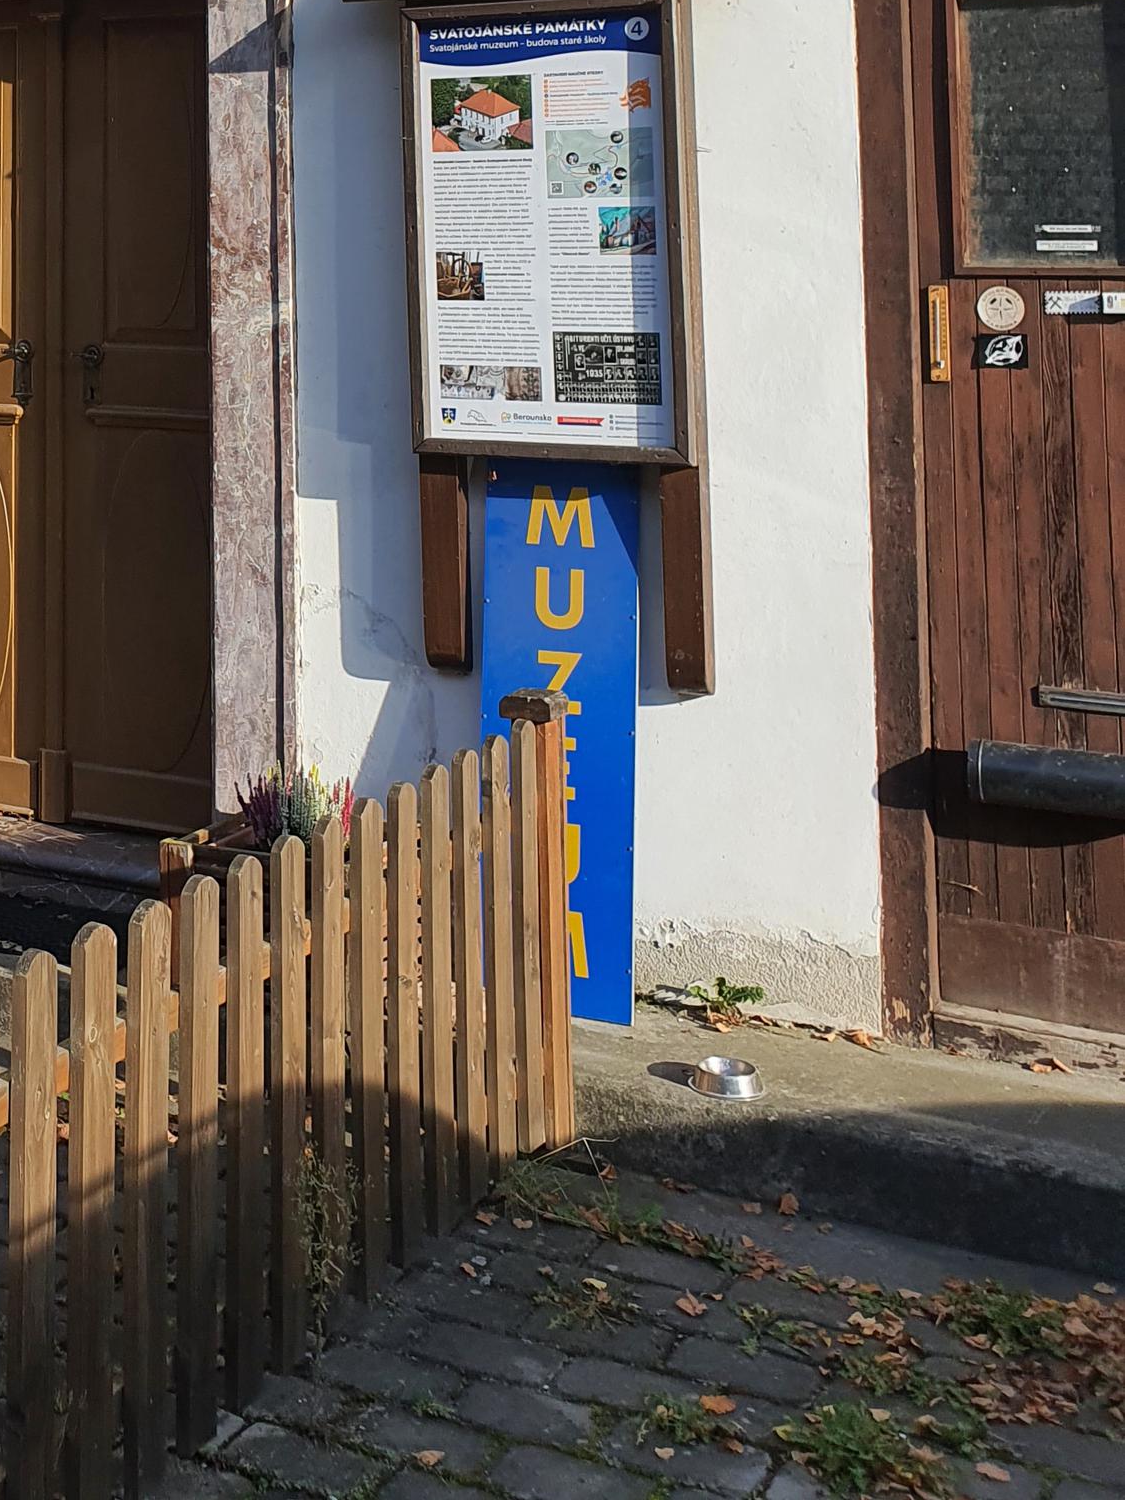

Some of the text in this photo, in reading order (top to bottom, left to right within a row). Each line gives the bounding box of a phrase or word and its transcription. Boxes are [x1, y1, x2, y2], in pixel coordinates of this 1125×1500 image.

[430, 19, 643, 40] SVATOJÁNSKÉ PAMÁTKY 4
[429, 42, 478, 53] Svatojánské
[526, 38, 559, 47] budova
[560, 36, 582, 45] staré
[584, 35, 606, 45] školy
[513, 412, 552, 422] Berounsko
